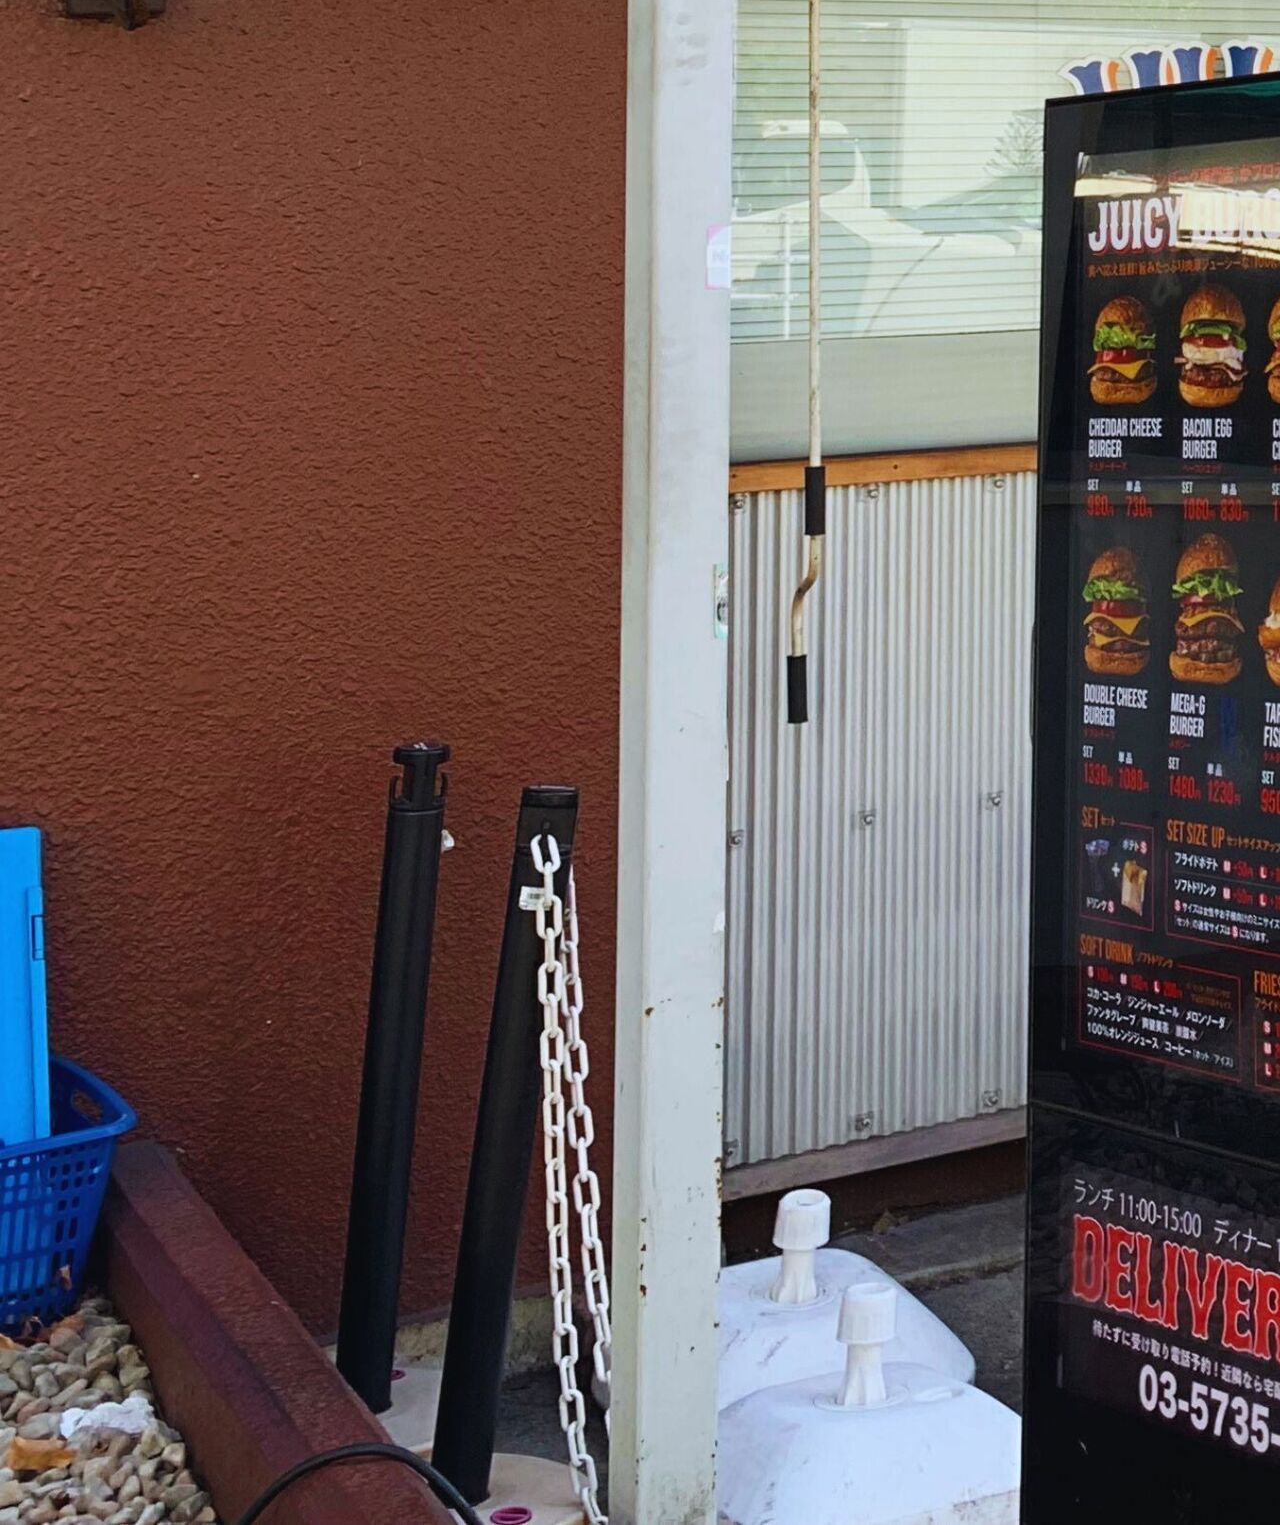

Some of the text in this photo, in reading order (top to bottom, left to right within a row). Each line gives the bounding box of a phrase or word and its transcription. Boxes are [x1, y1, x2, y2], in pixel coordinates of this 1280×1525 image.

[1088, 195, 1186, 255] JUICY
[1088, 418, 1163, 438] CHEDDAR CHEESE
[1183, 418, 1232, 438] BACON EGG
[1088, 439, 1122, 458] BURGER
[1182, 440, 1217, 459] BURGER
[1087, 479, 1099, 491] SET
[1181, 481, 1193, 494] SET
[1084, 683, 1148, 709] DOUBLE CHEESE
[1171, 692, 1205, 716] MEGA-G
[1083, 705, 1116, 727] BURGER
[1170, 715, 1205, 738] BURGER
[1082, 745, 1094, 758] SET
[1168, 757, 1180, 770] SET
[1262, 770, 1275, 785] SET
[1082, 805, 1099, 828] SET
[1167, 819, 1185, 842] SET
[1186, 824, 1208, 847] SIZE
[1211, 826, 1225, 849] UP
[1080, 933, 1103, 957] SOFT
[1105, 938, 1134, 966] DRINK
[1074, 1179, 1115, 1211] ランチ
[1119, 1192, 1202, 1238] 11:00-15:00
[1213, 1219, 1272, 1254] ディナー
